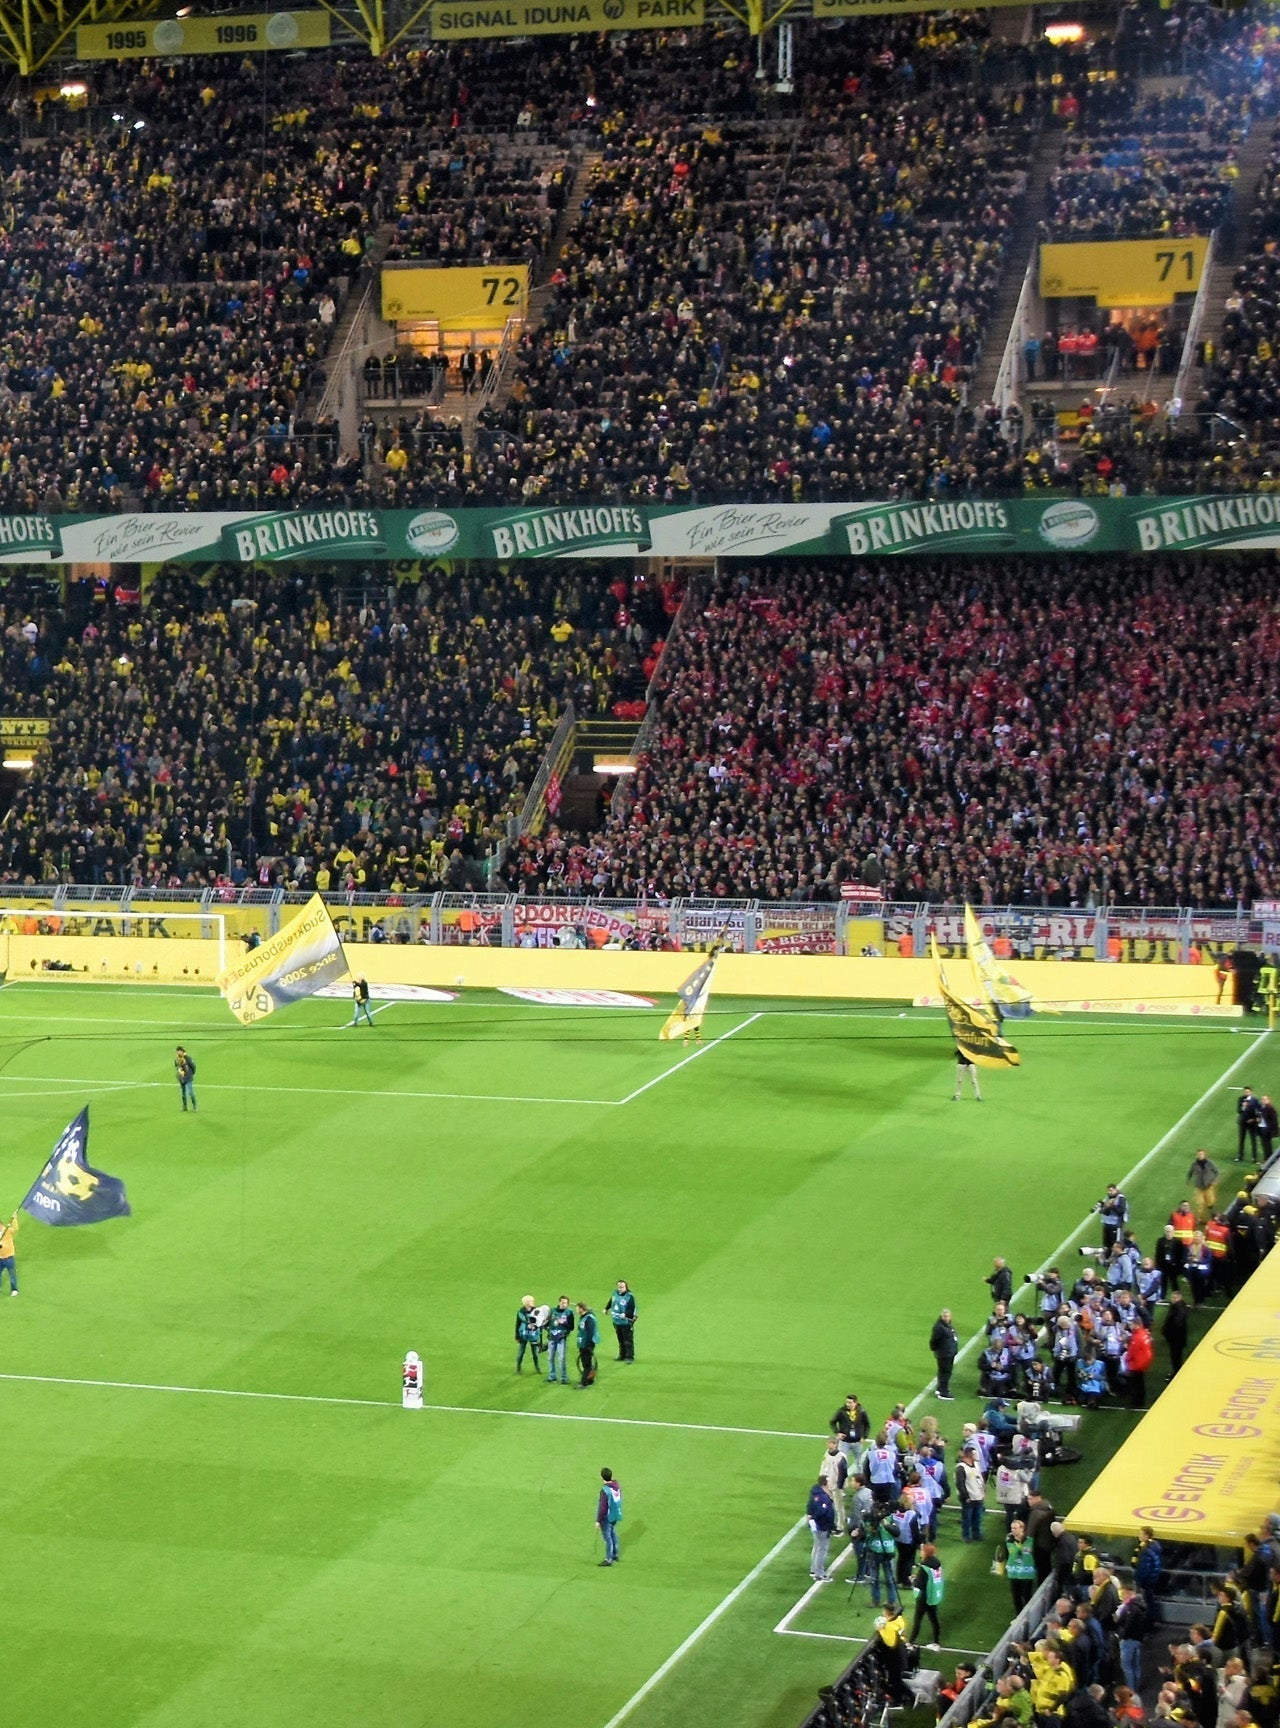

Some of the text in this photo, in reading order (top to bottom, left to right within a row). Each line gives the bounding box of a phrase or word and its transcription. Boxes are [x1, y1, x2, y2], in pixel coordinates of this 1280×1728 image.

[440, 0, 697, 29] SIGNAL IDUNA PARK
[106, 30, 146, 50] 1995
[215, 24, 257, 44] 1996
[1155, 251, 1194, 282] 71
[482, 277, 516, 306] 72
[94, 517, 156, 556] Ein Bier
[131, 534, 154, 548] sein
[156, 521, 203, 540] Revier
[686, 508, 757, 549] Ein Bier
[730, 524, 754, 540] sein
[756, 513, 809, 533] Revier
[0, 720, 50, 735] NTB
[1220, 1376, 1280, 1420] EVONIK
[1162, 1453, 1229, 1502] EVONIK
